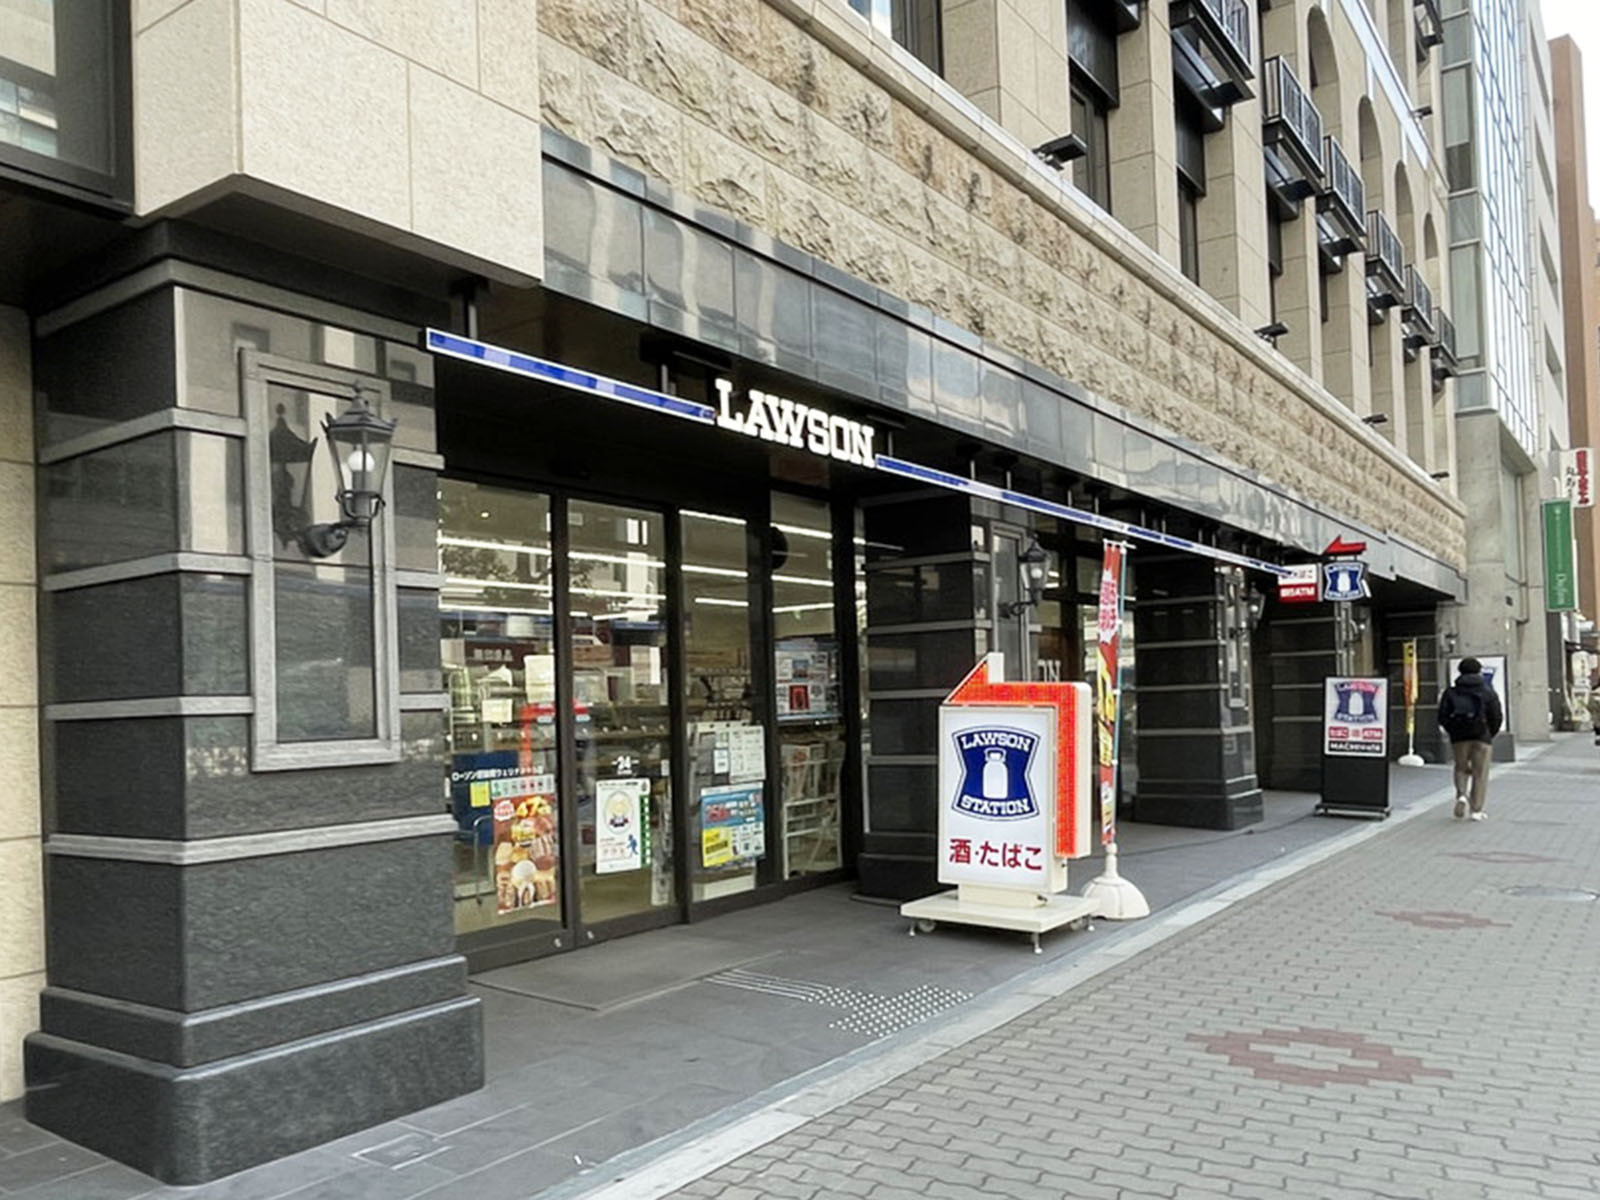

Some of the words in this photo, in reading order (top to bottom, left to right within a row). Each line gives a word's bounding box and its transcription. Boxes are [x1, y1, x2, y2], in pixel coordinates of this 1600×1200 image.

[715, 378, 875, 468] LAWSON
[960, 731, 1032, 752] LAWSON
[960, 794, 1031, 815] STATION
